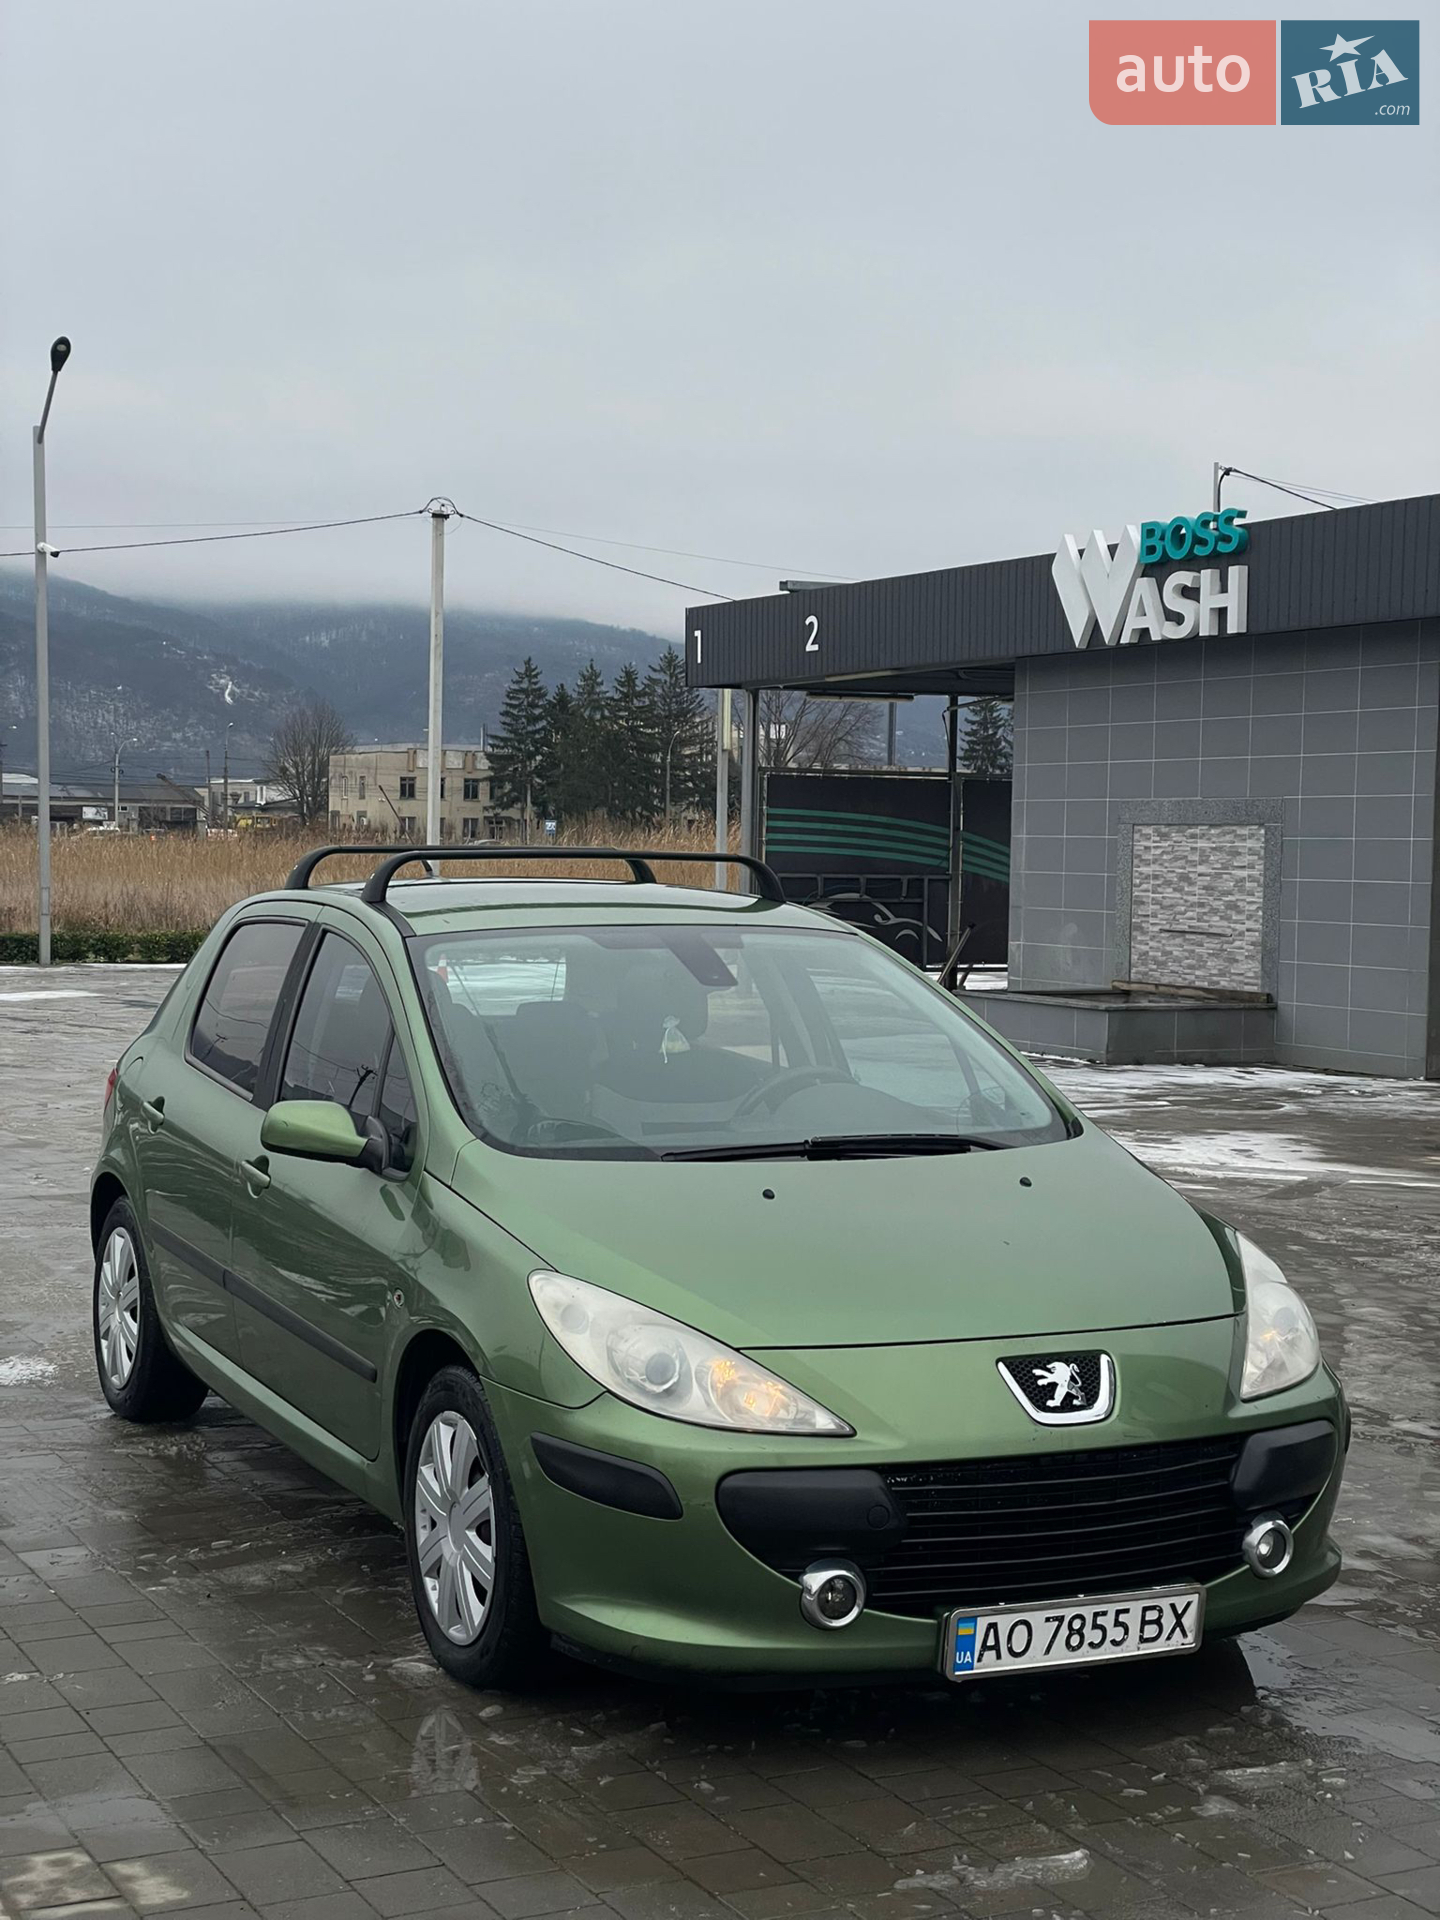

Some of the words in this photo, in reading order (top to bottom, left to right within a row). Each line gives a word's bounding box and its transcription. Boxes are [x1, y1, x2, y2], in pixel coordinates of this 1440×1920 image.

[1139, 507, 1248, 564] BOSS
[1051, 524, 1249, 649] WASH
[694, 629, 702, 664] 1
[804, 614, 820, 652] 2
[976, 1618, 1033, 1664] AO
[1043, 1607, 1131, 1656] 7855
[1138, 1600, 1193, 1644] BX
[955, 1650, 973, 1664] UA
